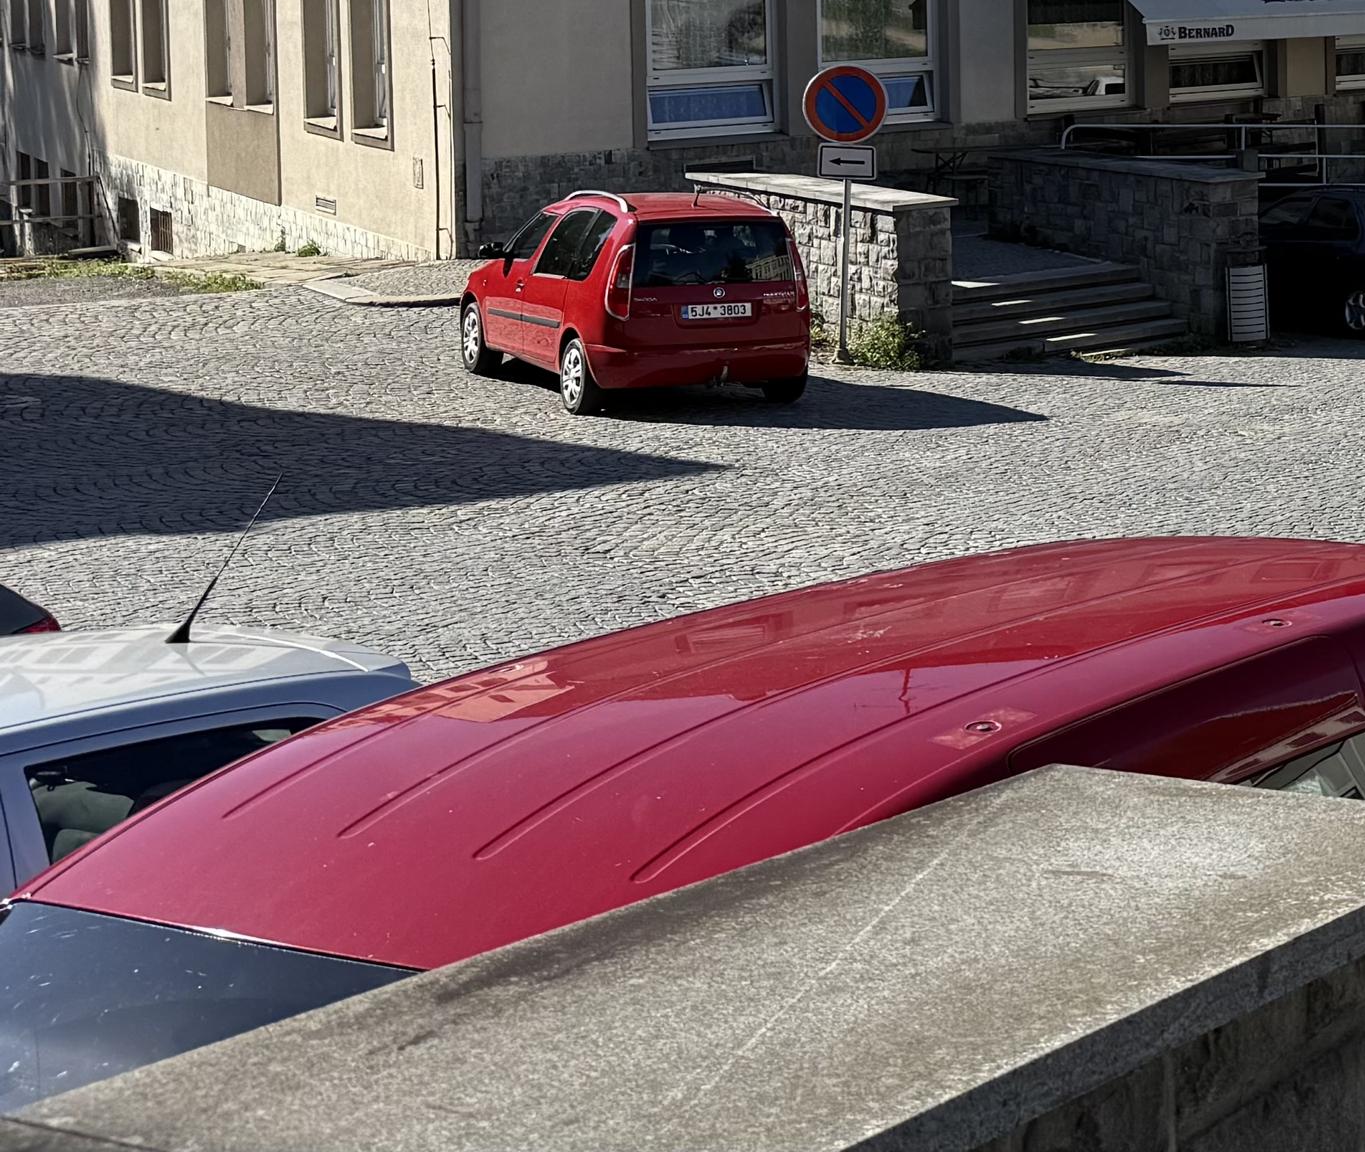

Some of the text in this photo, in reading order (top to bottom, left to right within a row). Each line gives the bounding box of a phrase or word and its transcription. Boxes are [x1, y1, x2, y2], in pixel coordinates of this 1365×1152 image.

[1178, 24, 1235, 39] BERNARD
[690, 303, 747, 318] 5J4 3803
